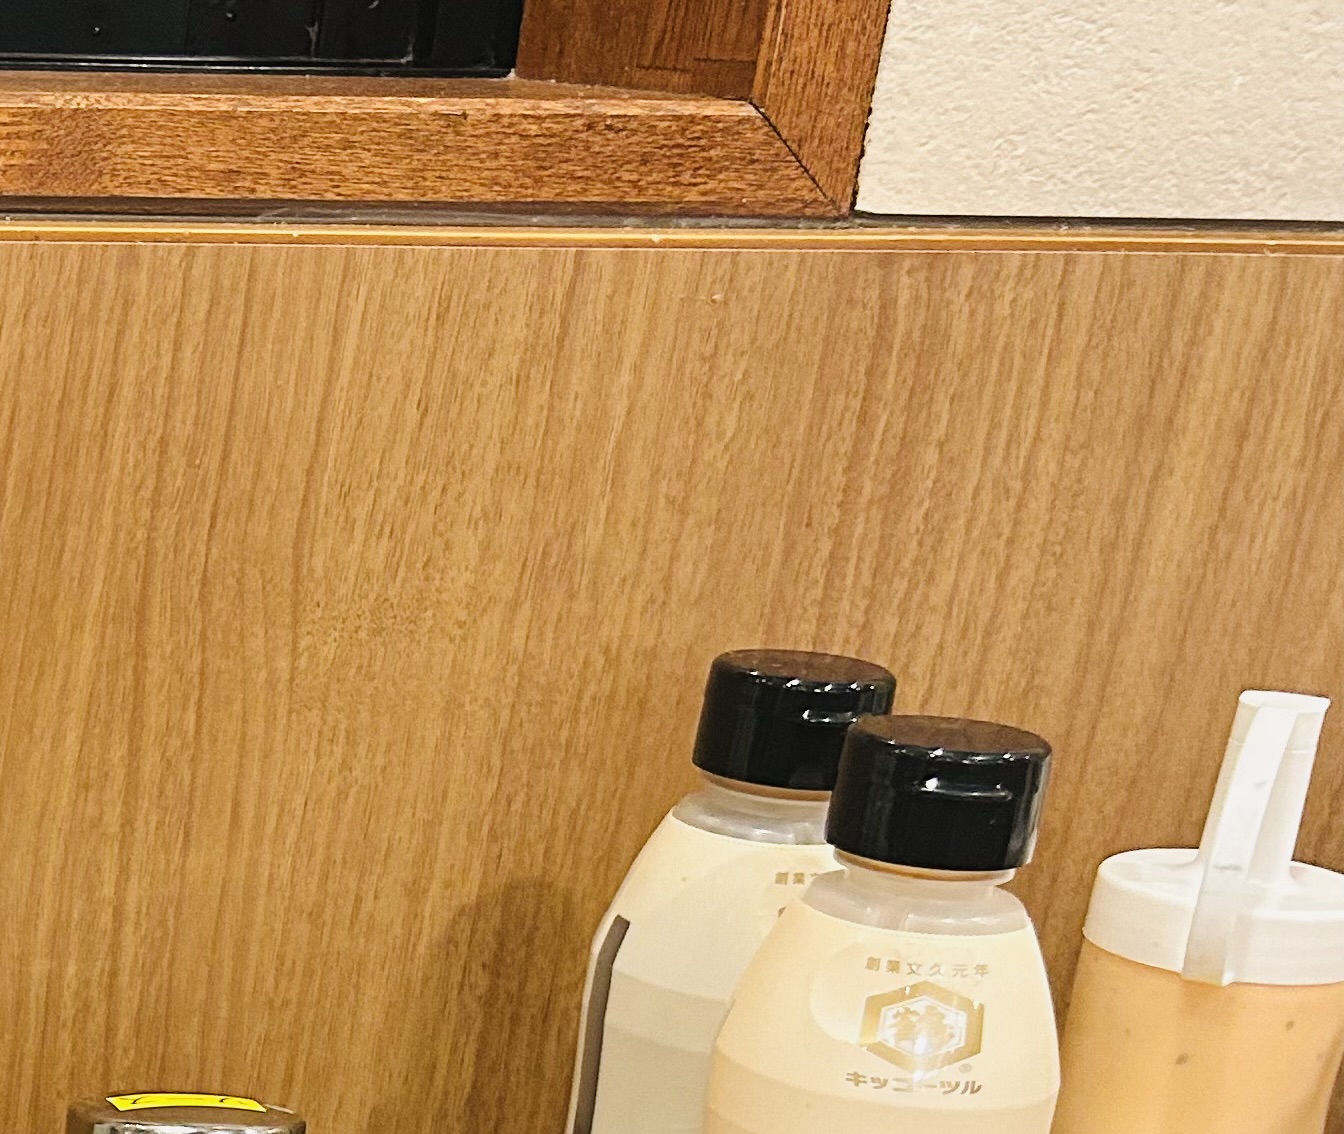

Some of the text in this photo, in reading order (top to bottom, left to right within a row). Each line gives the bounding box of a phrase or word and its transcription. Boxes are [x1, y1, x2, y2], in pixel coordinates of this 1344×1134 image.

[845, 1070, 983, 1096] キッコーツル
